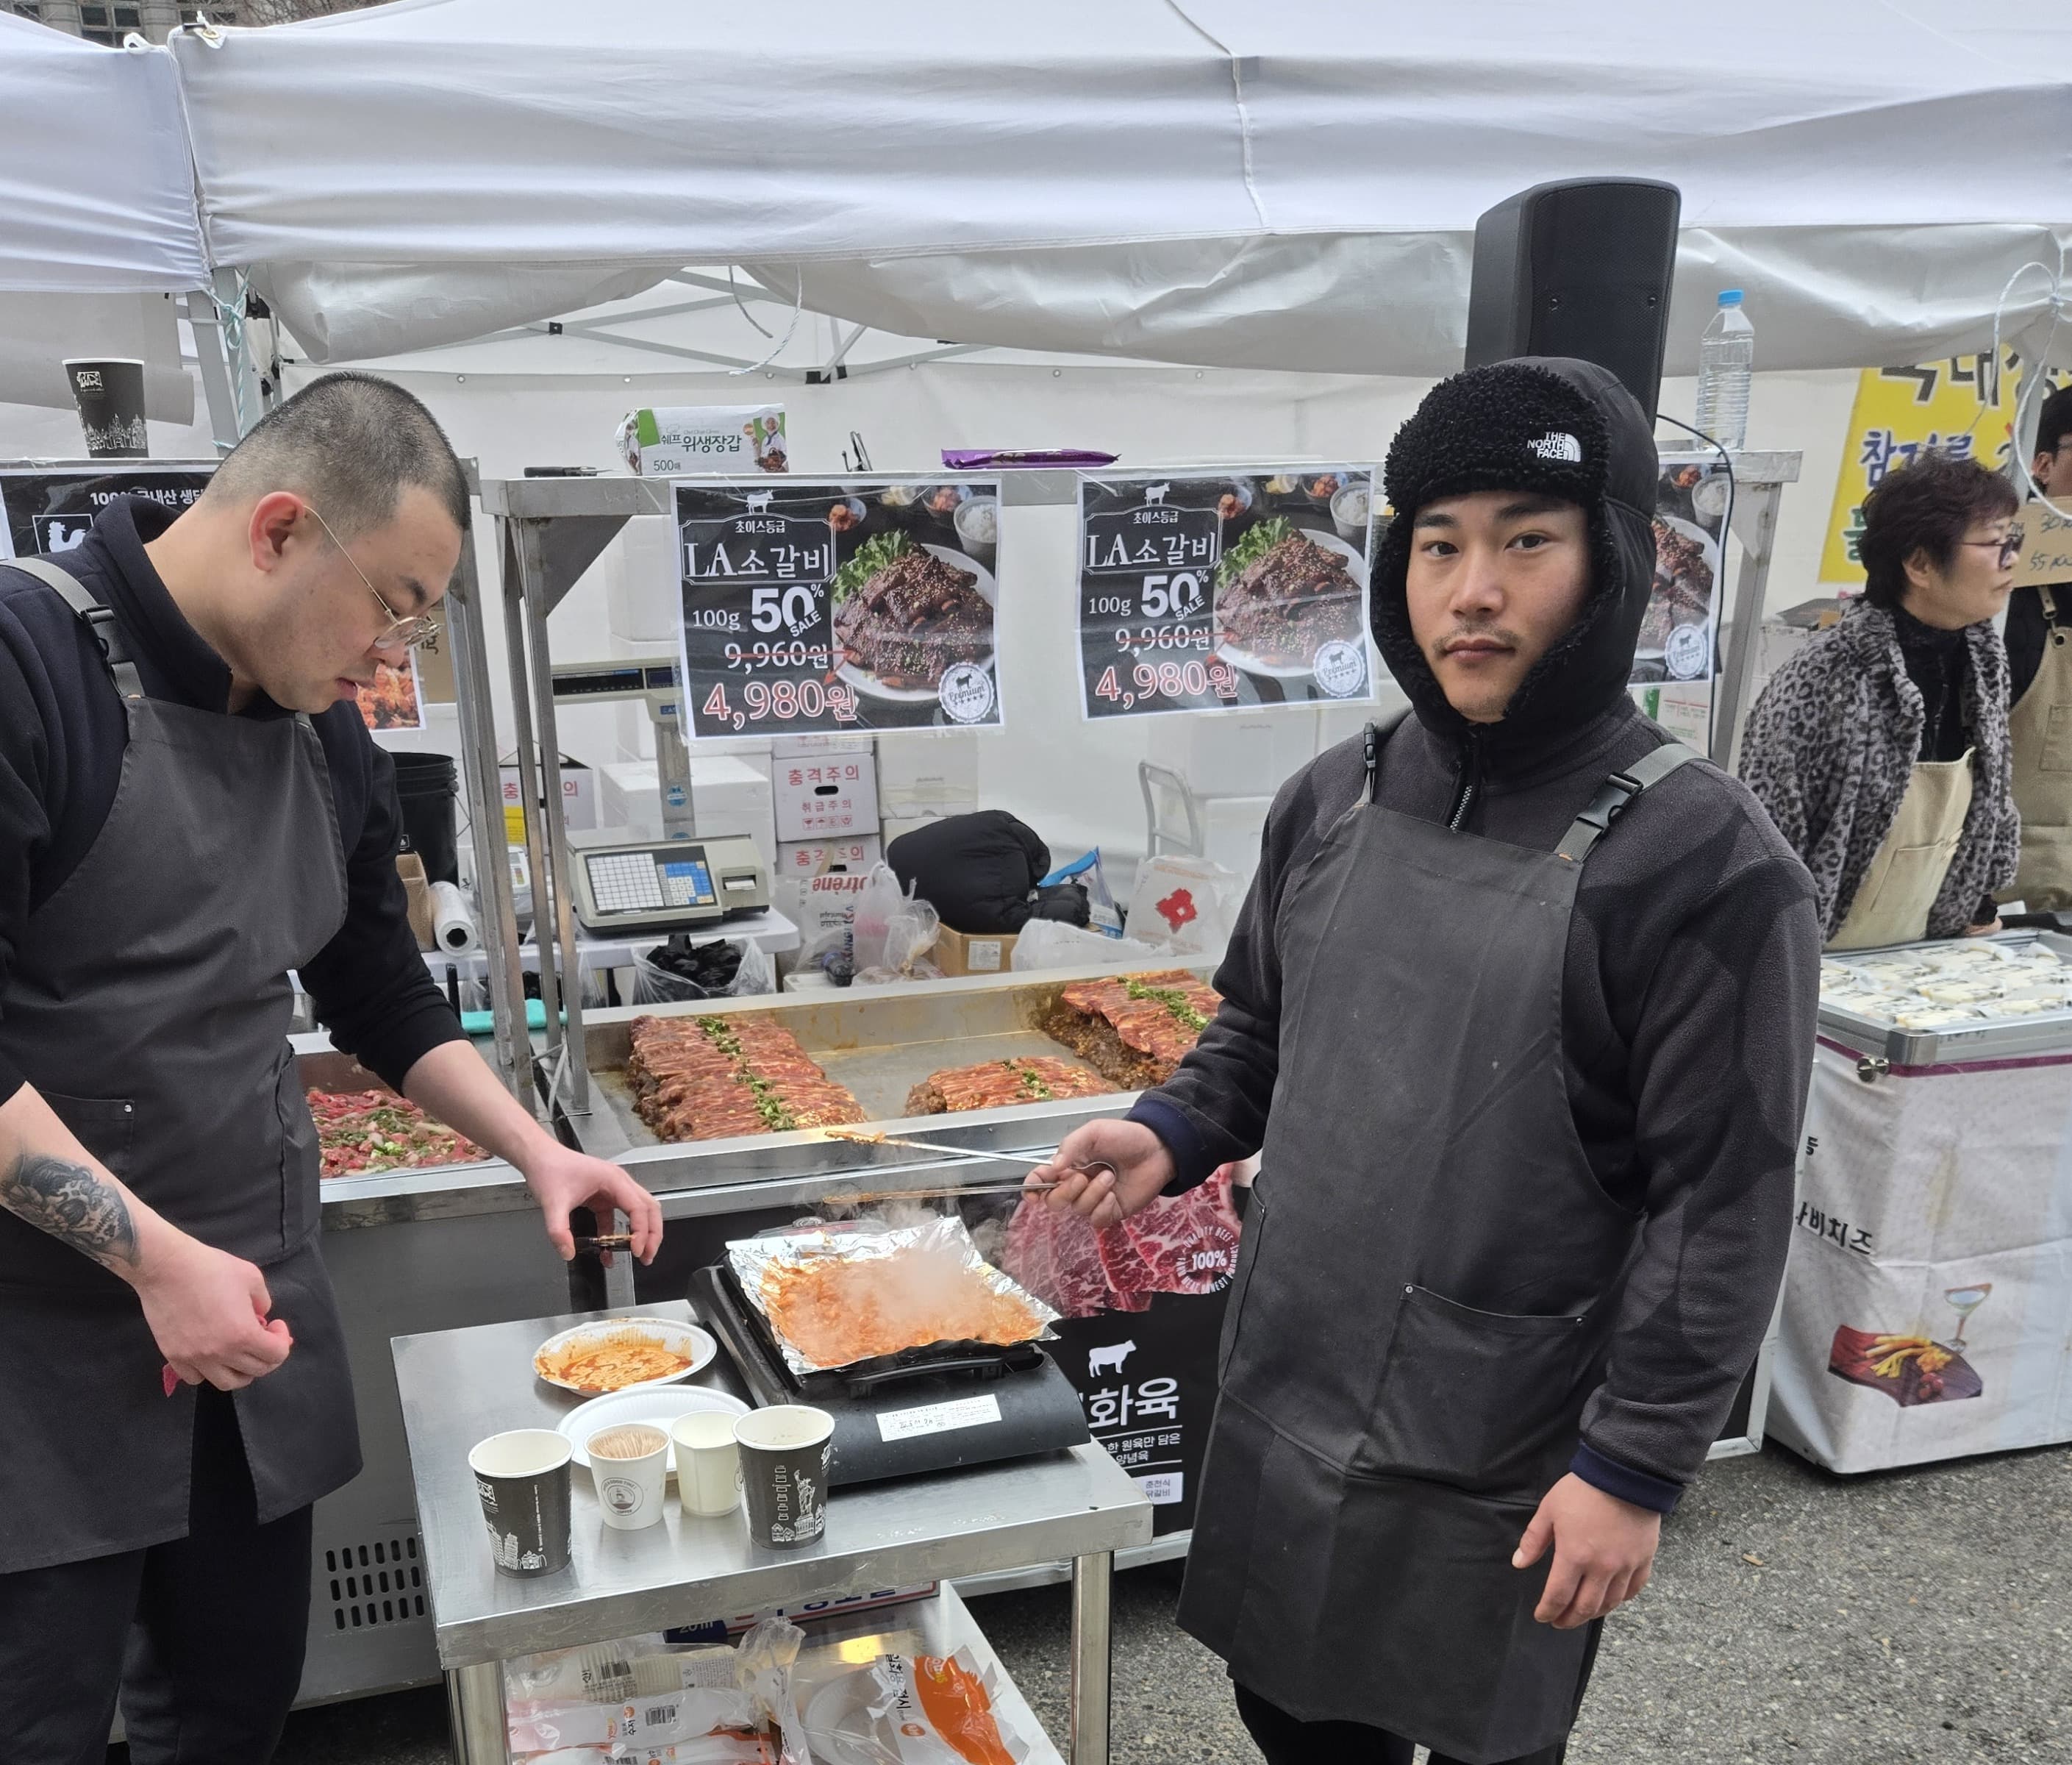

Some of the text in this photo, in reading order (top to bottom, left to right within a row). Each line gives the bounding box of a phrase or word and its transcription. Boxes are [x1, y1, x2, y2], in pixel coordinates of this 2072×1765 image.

[661, 434, 742, 453] 쉐프 위생장갑
[1527, 439, 1565, 452] NORTH
[1546, 432, 1565, 441] THE
[1537, 449, 1564, 460] FACE
[735, 520, 785, 533] 초이스등급
[1133, 511, 1179, 524] 초이스등급
[1089, 596, 1132, 616] 100g
[1175, 595, 1205, 621] SALE
[693, 610, 740, 631] 100g
[790, 610, 822, 637] SALE
[1115, 625, 1210, 657] 9,960원
[724, 641, 829, 675] 9,960원
[1095, 661, 1238, 710] 4,980원
[702, 679, 857, 730] 4,980원
[788, 765, 860, 786] 충격주의
[801, 799, 851, 813] 취급주의
[1215, 1227, 1233, 1242] BEEF
[1192, 1249, 1227, 1270] 100%
[1201, 1276, 1229, 1294] HONEST
[1079, 1377, 1179, 1429] 화육
[1121, 1436, 1155, 1452] 원육만
[1158, 1433, 1181, 1446] 담은
[1116, 1450, 1149, 1466] 양념육
